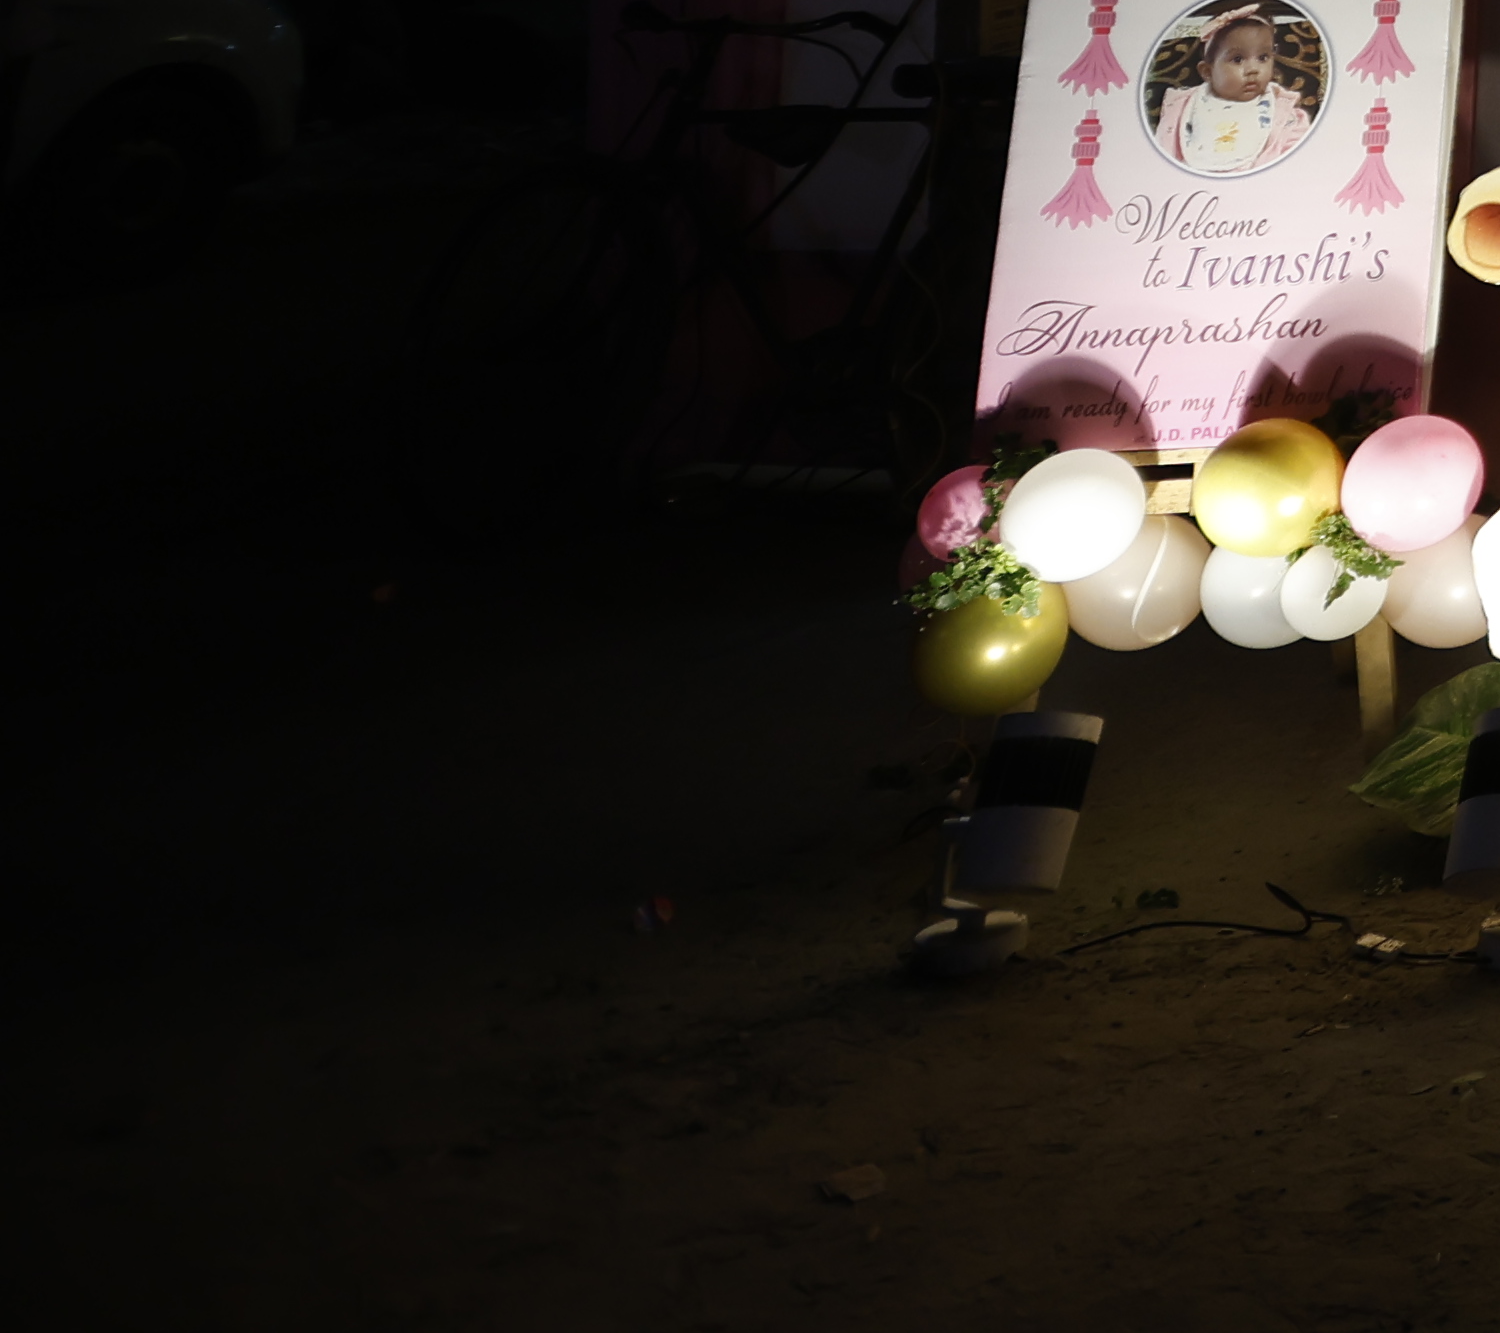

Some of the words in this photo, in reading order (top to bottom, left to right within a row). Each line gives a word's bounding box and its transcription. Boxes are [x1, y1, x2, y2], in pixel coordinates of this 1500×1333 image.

[1115, 190, 1271, 245] Welcome
[1142, 245, 1170, 289] to
[1176, 232, 1390, 290] Ivanshi's
[996, 293, 1330, 377] Annaprashan
[1016, 406, 1050, 420] am
[1062, 380, 1128, 427] ready
[1134, 374, 1172, 425] for
[1180, 395, 1215, 422] my
[1222, 369, 1273, 420] first
[1282, 364, 1343, 406] bowl
[1151, 428, 1185, 443] J.D.
[1190, 425, 1238, 440] PALA
